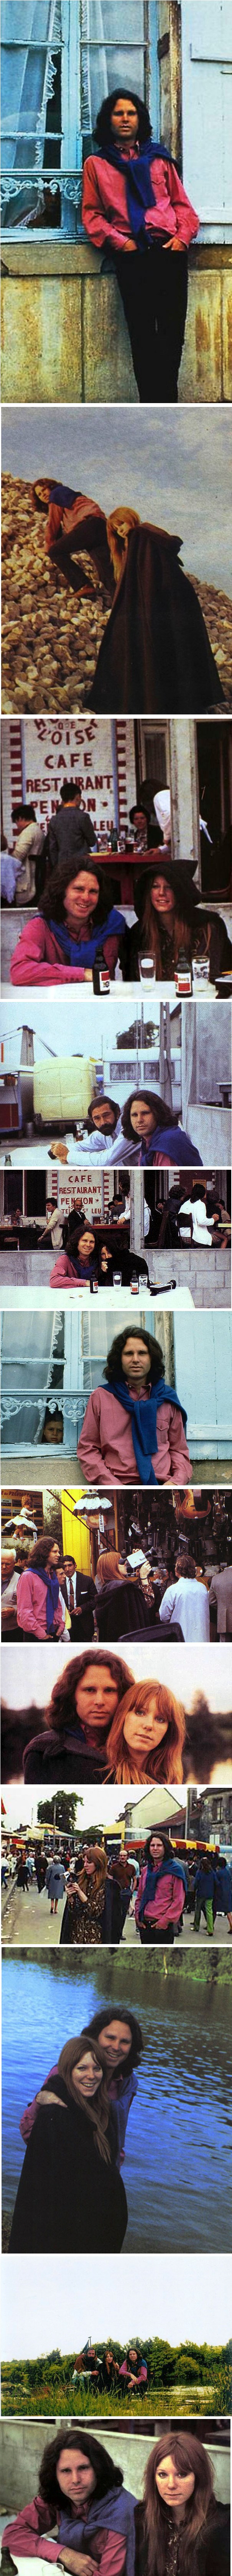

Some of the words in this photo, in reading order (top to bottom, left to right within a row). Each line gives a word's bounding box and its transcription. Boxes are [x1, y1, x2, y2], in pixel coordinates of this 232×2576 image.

[37, 726, 95, 745] L'OISE
[44, 752, 93, 769] CAFE
[30, 798, 96, 814] PENON
